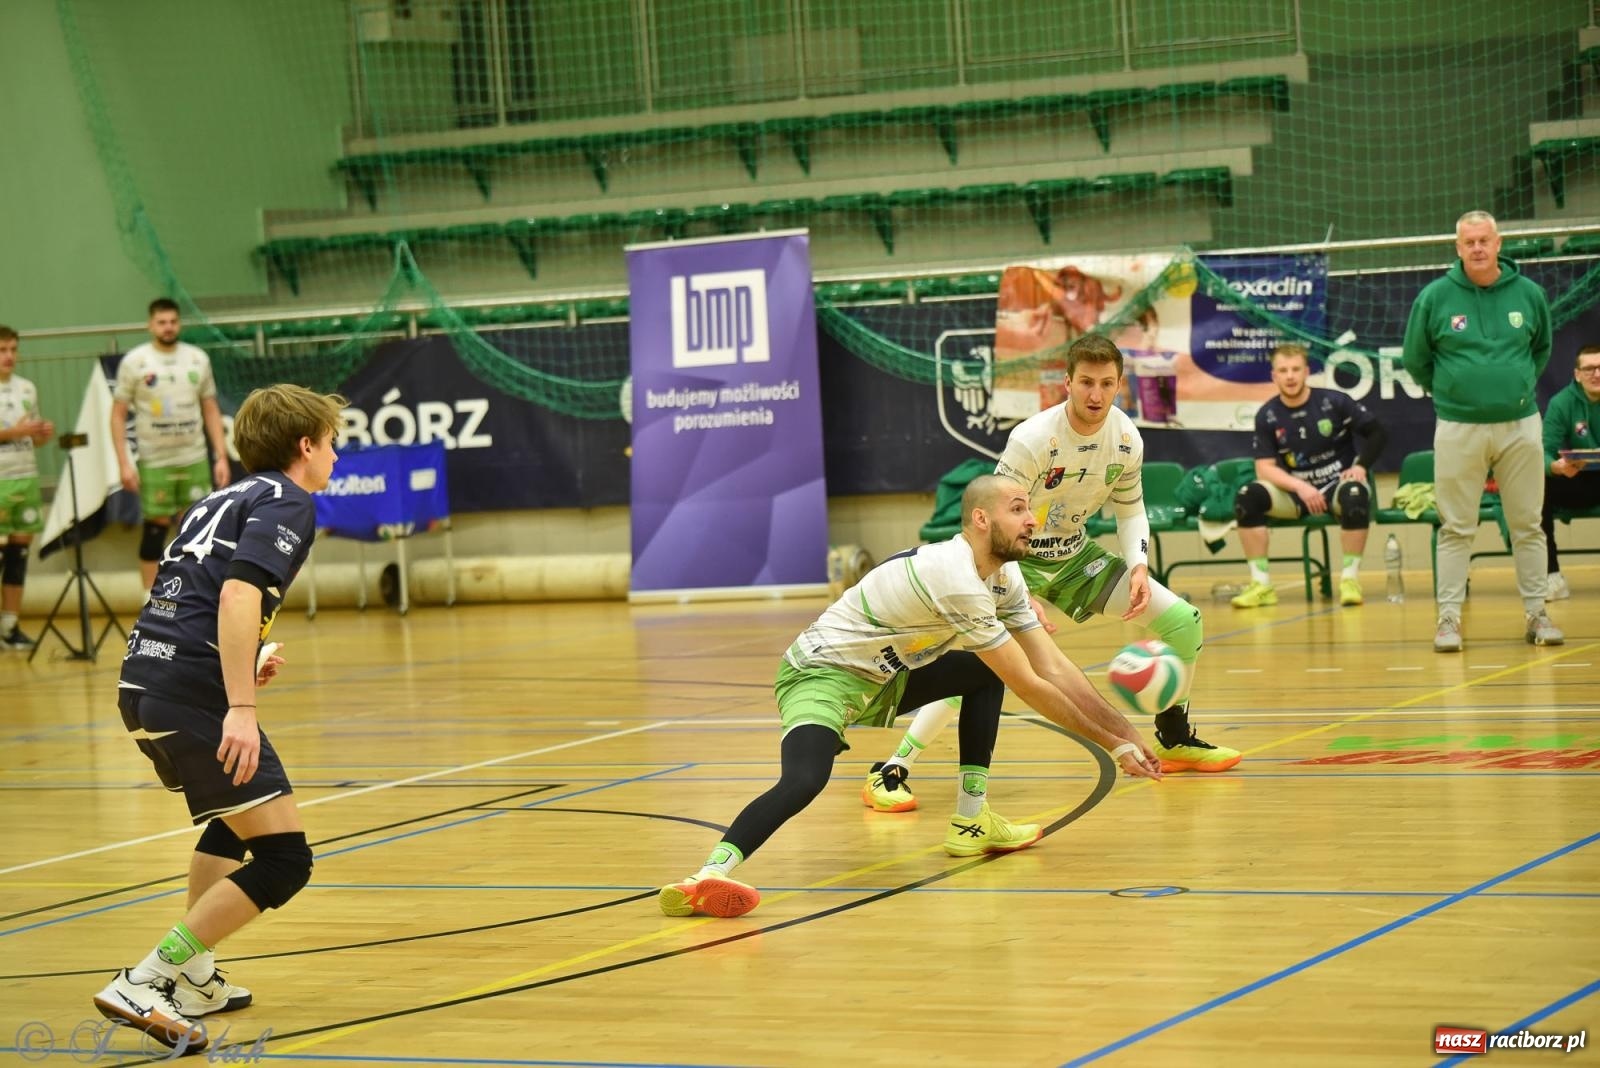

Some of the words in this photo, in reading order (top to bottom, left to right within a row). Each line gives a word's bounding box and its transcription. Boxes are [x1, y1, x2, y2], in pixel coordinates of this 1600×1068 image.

[1207, 276, 1313, 298] exadin
[675, 271, 764, 366] bmp
[1309, 331, 1433, 401] ÓR
[646, 388, 718, 409] budujemy
[719, 381, 800, 403] możliwości
[674, 408, 774, 434] porozumienia
[1299, 426, 1307, 440] 2
[1078, 468, 1087, 483] 7
[1028, 536, 1062, 549] OMPY
